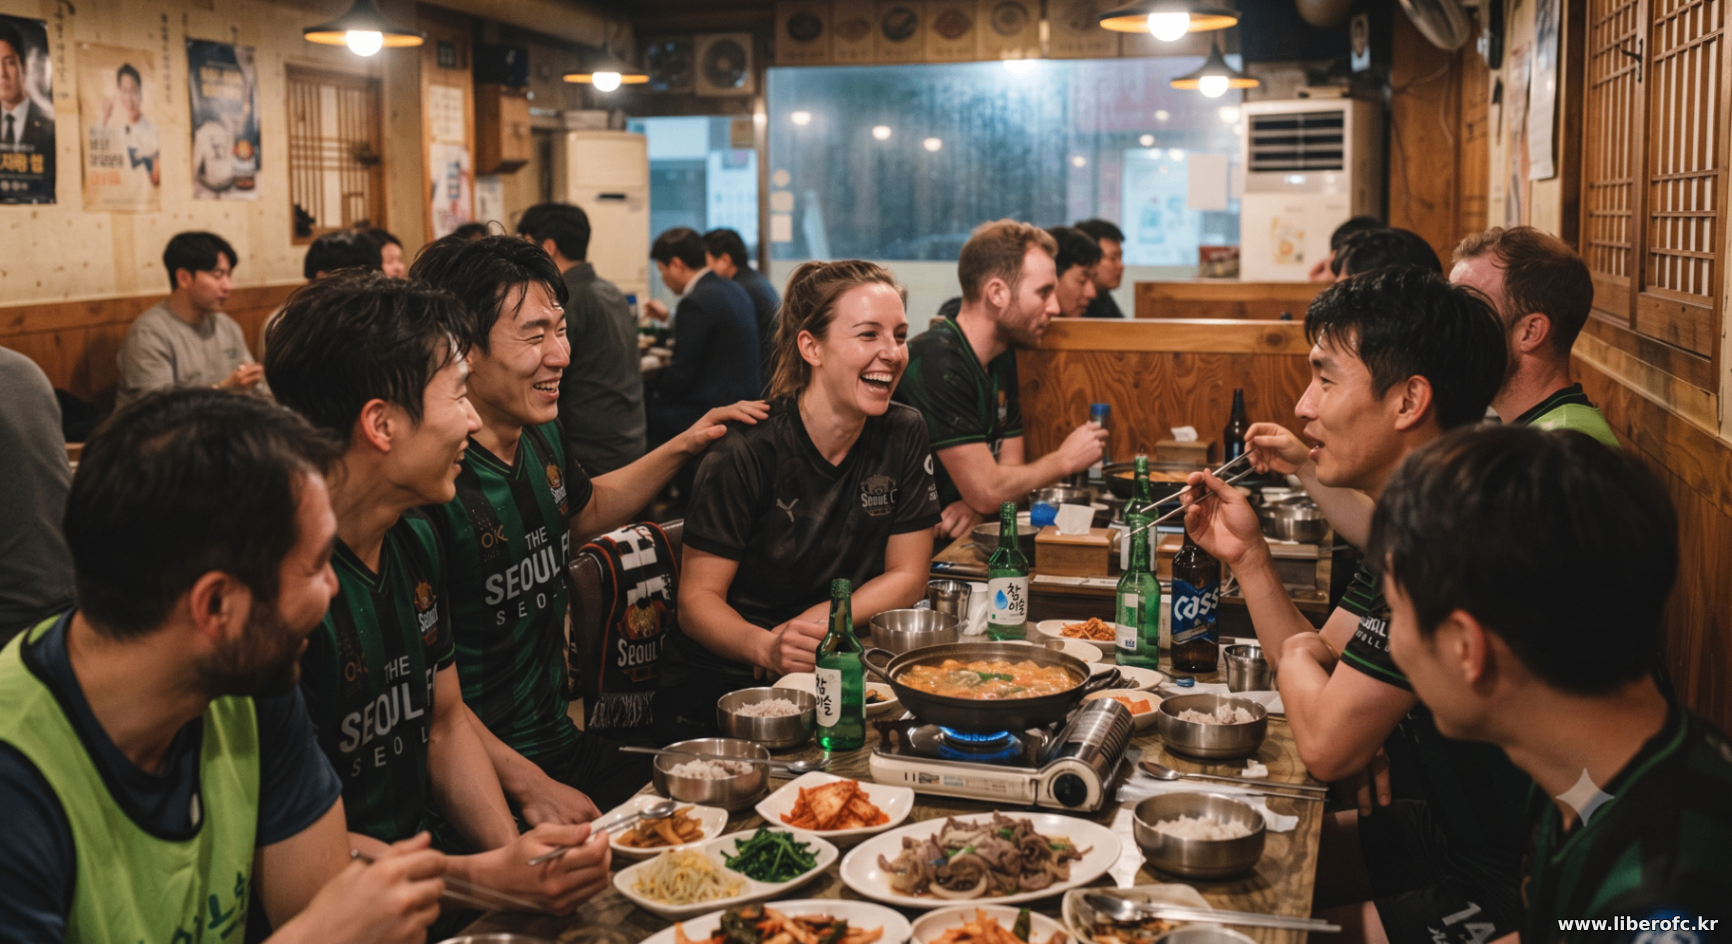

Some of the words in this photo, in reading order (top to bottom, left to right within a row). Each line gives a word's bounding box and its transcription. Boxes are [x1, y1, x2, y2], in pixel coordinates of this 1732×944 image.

[524, 526, 548, 550] THE
[485, 546, 560, 605] SEOUL
[1007, 582, 1021, 601] 참
[1008, 598, 1025, 616] 이슬
[384, 655, 411, 684] THE
